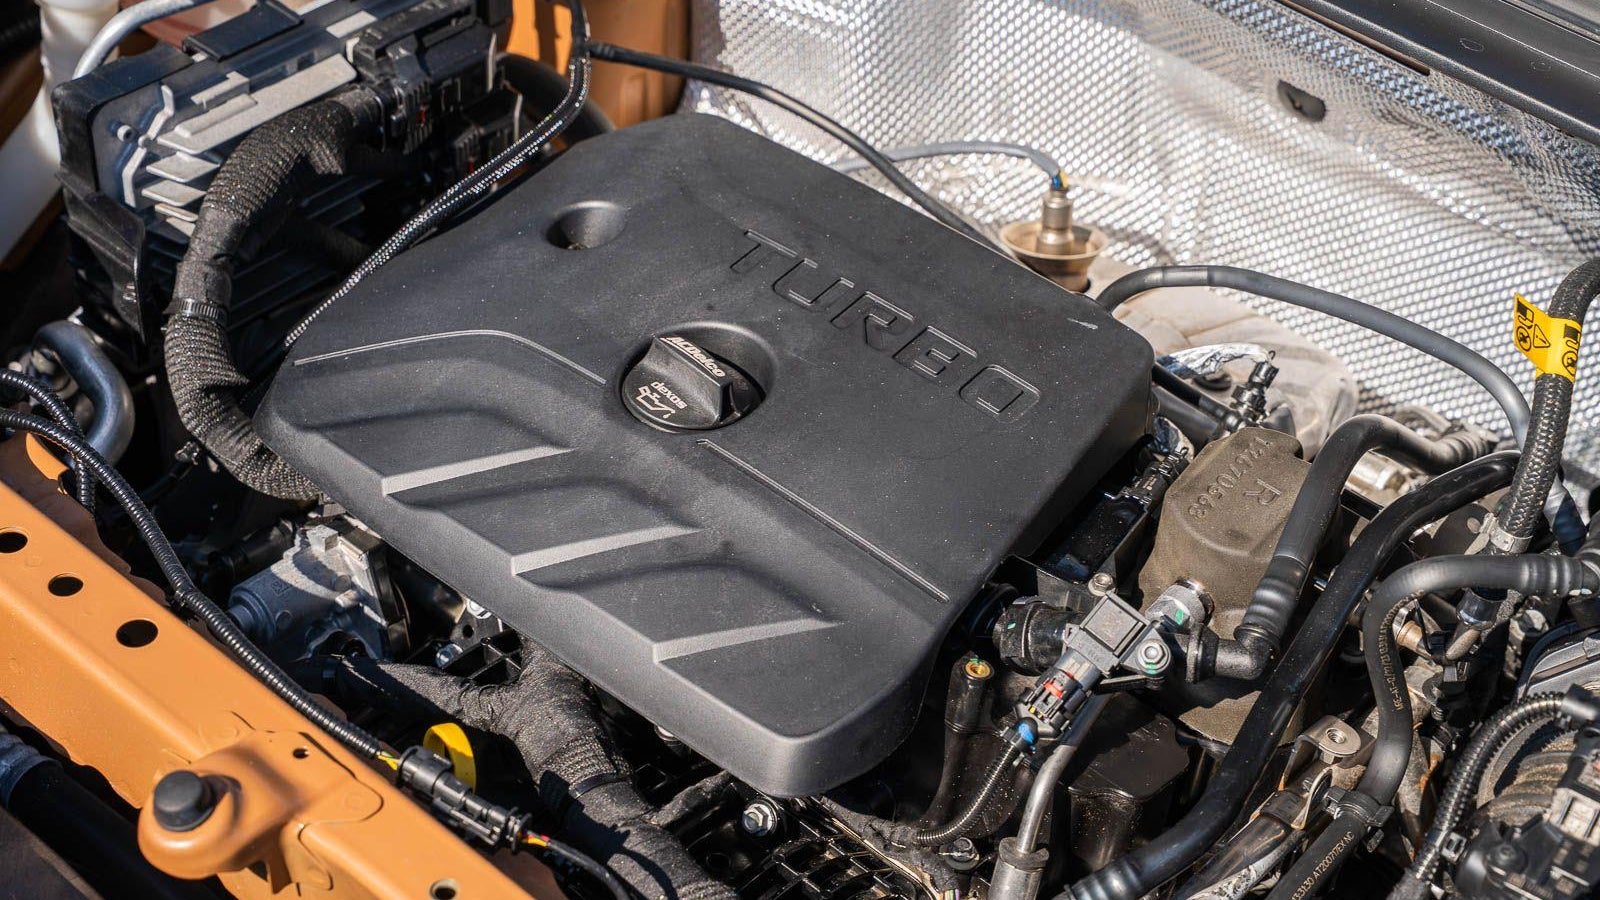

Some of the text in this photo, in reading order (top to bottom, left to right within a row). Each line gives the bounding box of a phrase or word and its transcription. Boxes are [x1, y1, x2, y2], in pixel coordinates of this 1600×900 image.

[729, 229, 1041, 423] TURBO
[660, 336, 726, 377] ACDelco
[650, 381, 688, 409] dexos
[1243, 477, 1282, 506] R
